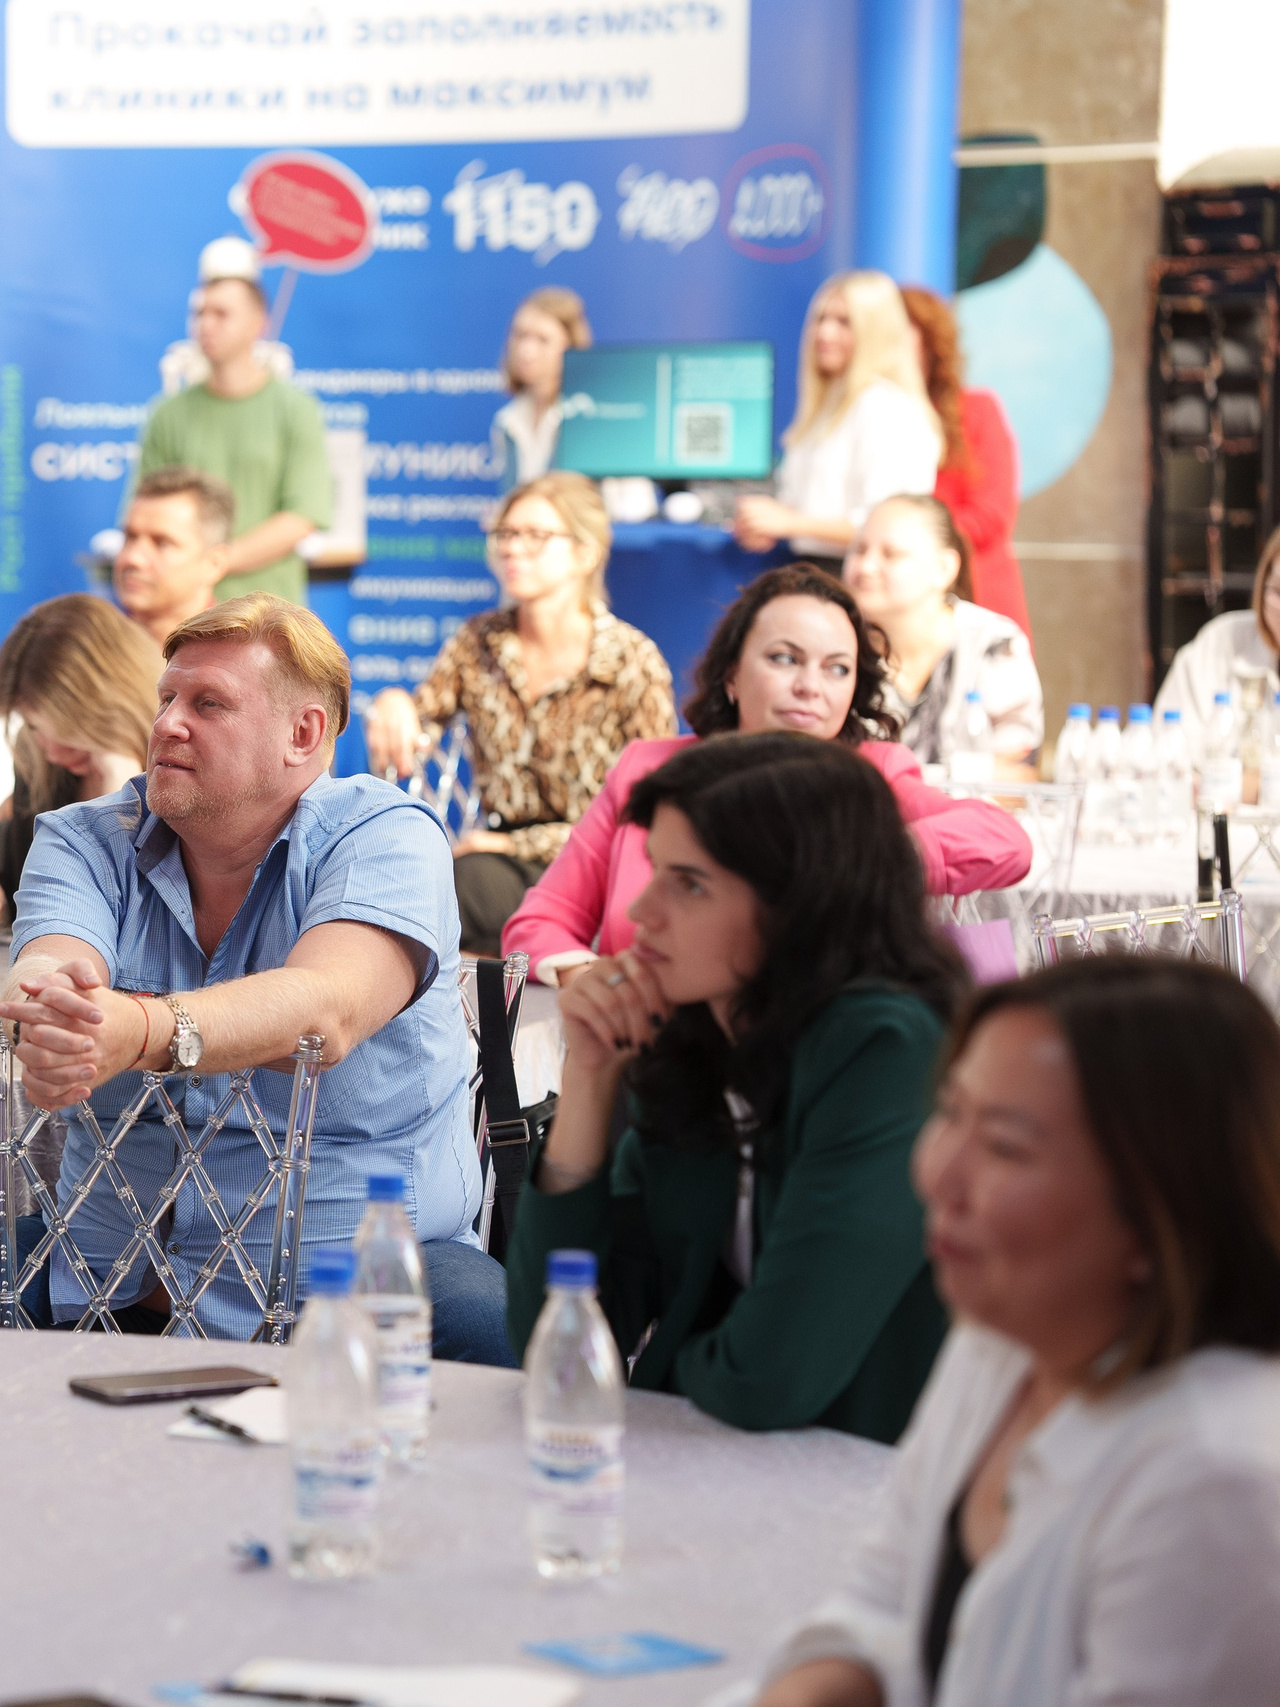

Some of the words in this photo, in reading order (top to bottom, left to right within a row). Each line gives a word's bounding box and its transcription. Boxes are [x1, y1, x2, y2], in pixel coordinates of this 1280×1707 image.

[48, 6, 329, 54] Прокачай
[351, 3, 725, 45] заполняемость
[48, 86, 284, 111] клиники
[305, 84, 370, 110] на
[389, 73, 652, 117] максимум
